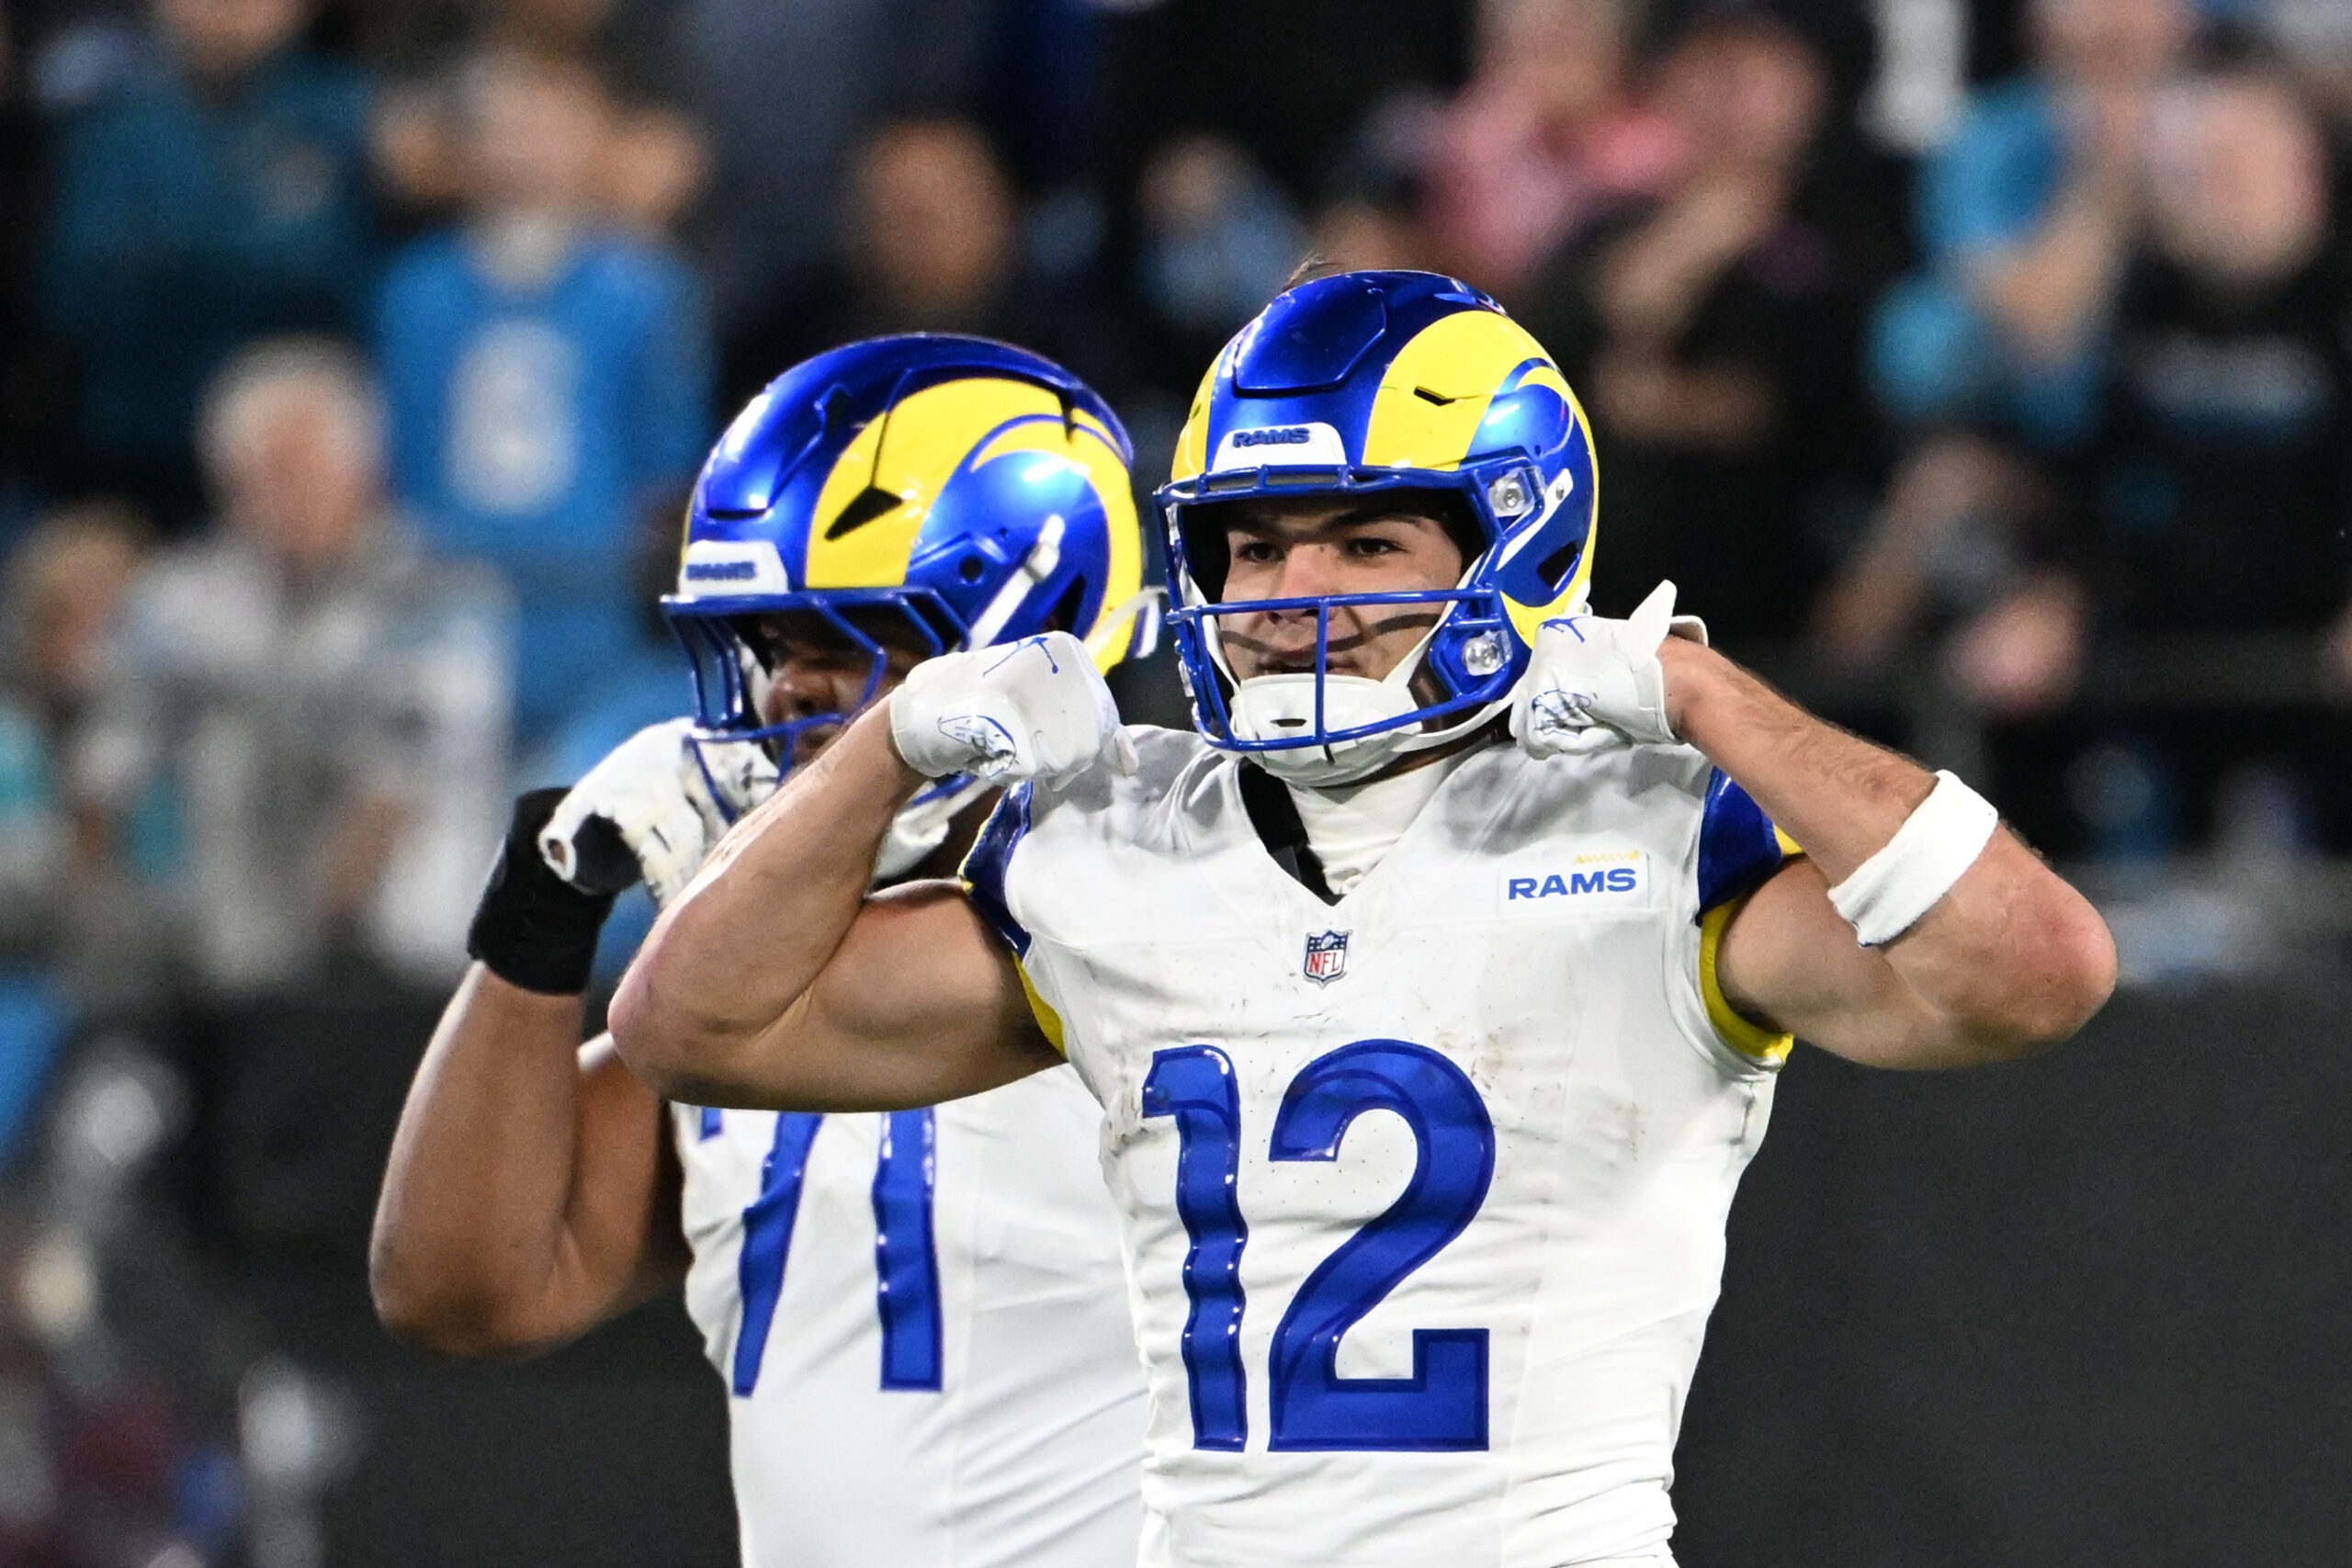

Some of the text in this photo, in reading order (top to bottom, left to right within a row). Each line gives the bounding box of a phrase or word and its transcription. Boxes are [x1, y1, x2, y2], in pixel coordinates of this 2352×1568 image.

[1232, 427, 1310, 448] RAMS
[1509, 868, 1636, 900] RAMS
[1308, 952, 1340, 976] NFL
[1142, 1039, 1496, 1452] 12
